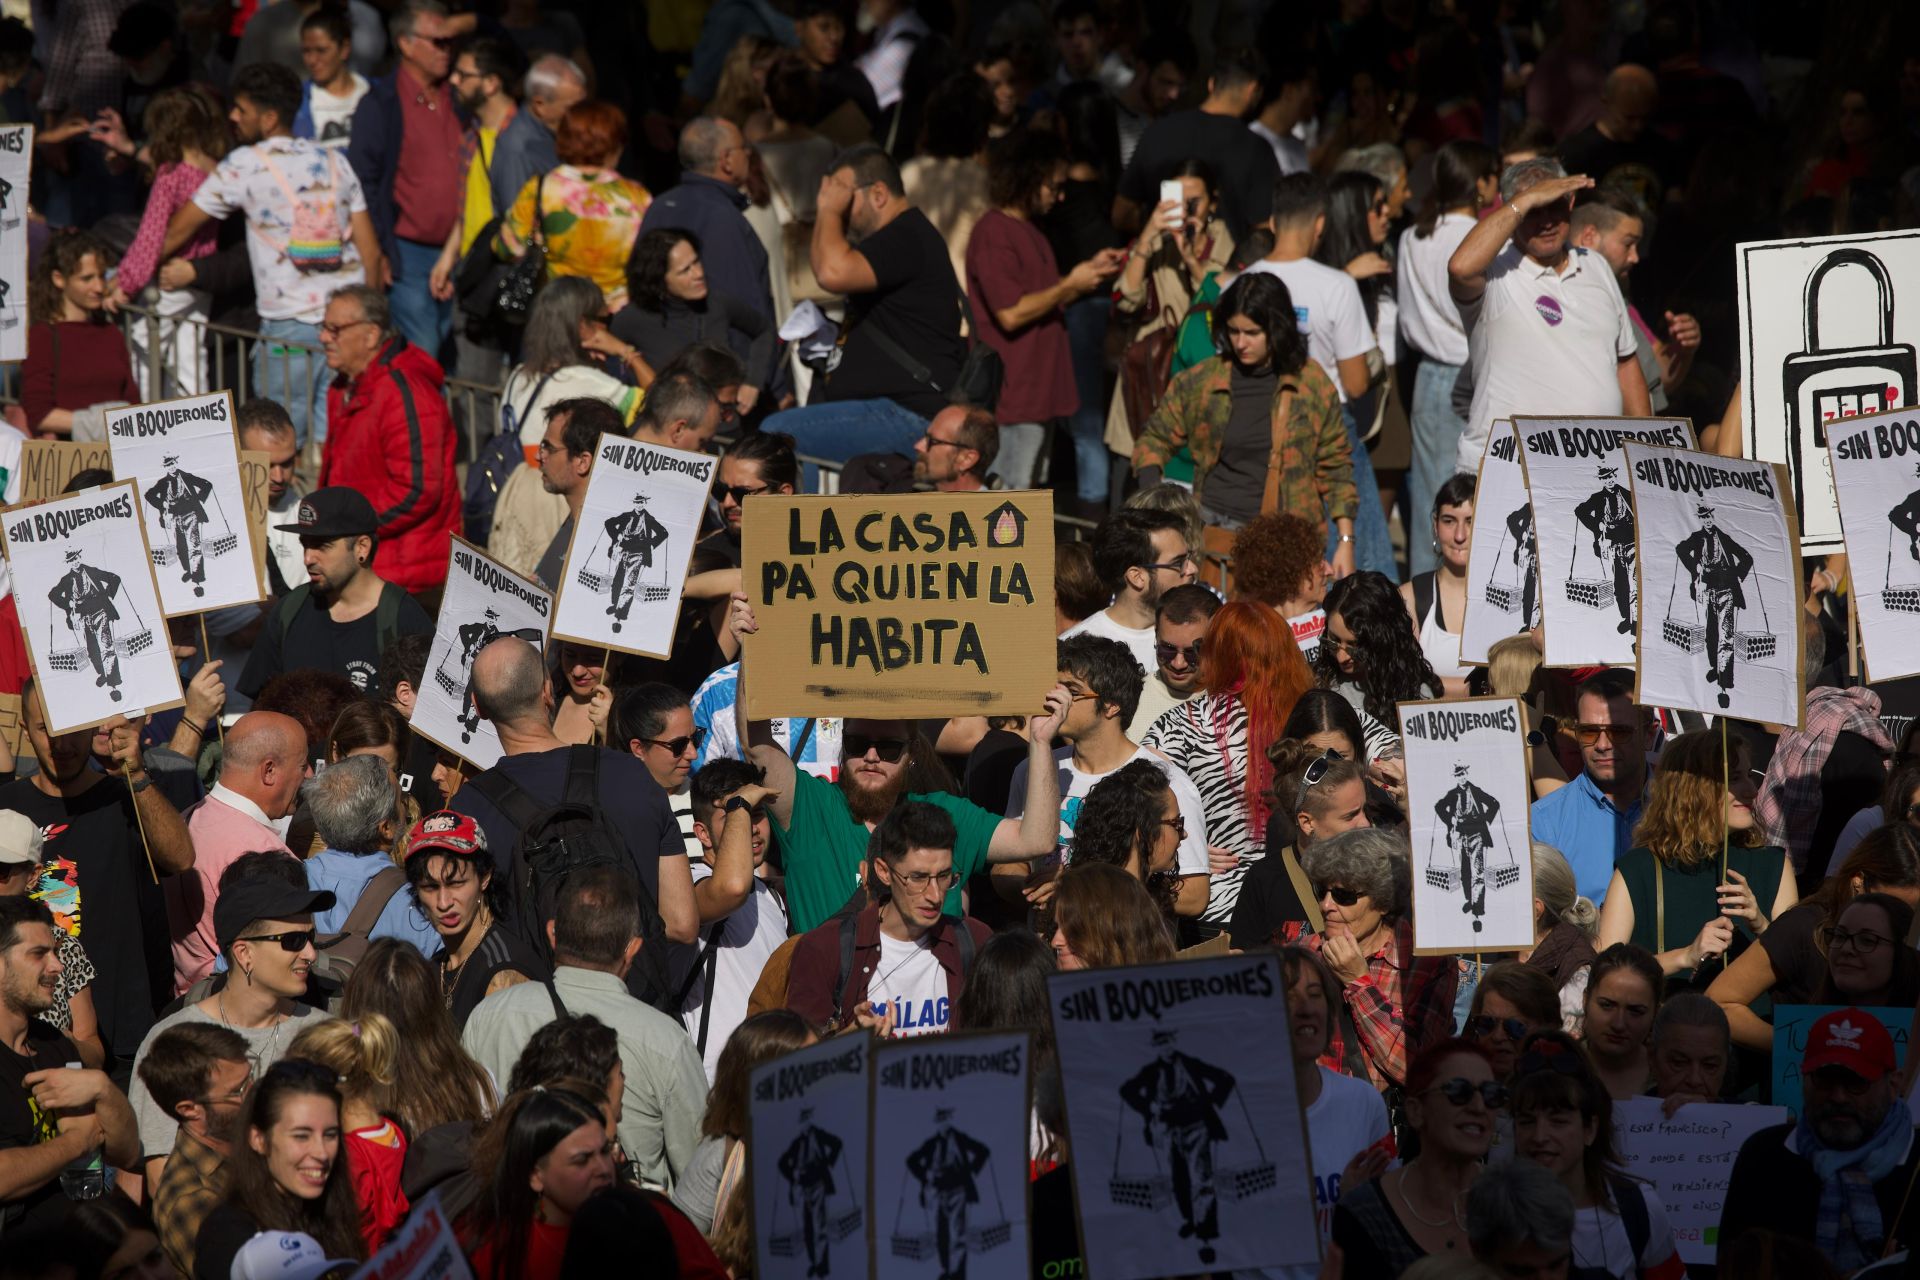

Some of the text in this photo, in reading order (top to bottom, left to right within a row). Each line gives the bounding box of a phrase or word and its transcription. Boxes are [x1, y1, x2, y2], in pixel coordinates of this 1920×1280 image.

[112, 398, 226, 437] SIN BOQUERONES
[601, 445, 712, 483] SIN BOQUERONES
[1491, 435, 1516, 462] SIN
[1527, 430, 1559, 457] SIN
[1837, 430, 1872, 459] SIN
[1636, 457, 1774, 499] SIN BOQUERONES
[9, 492, 132, 542] SIN BOQUERONES
[789, 507, 978, 555] LA CASA
[453, 551, 549, 618] SIN BOQUERONES
[832, 560, 979, 605] QUIEN
[989, 561, 1035, 604] LA
[810, 613, 990, 676] HABITA
[1406, 705, 1516, 742] SIN BOQUERONES
[1060, 962, 1273, 1023] SIN BOQUERONES
[755, 1044, 863, 1101] SIN BOQUERONES
[880, 1044, 1021, 1090] SIN BOQUERONES
